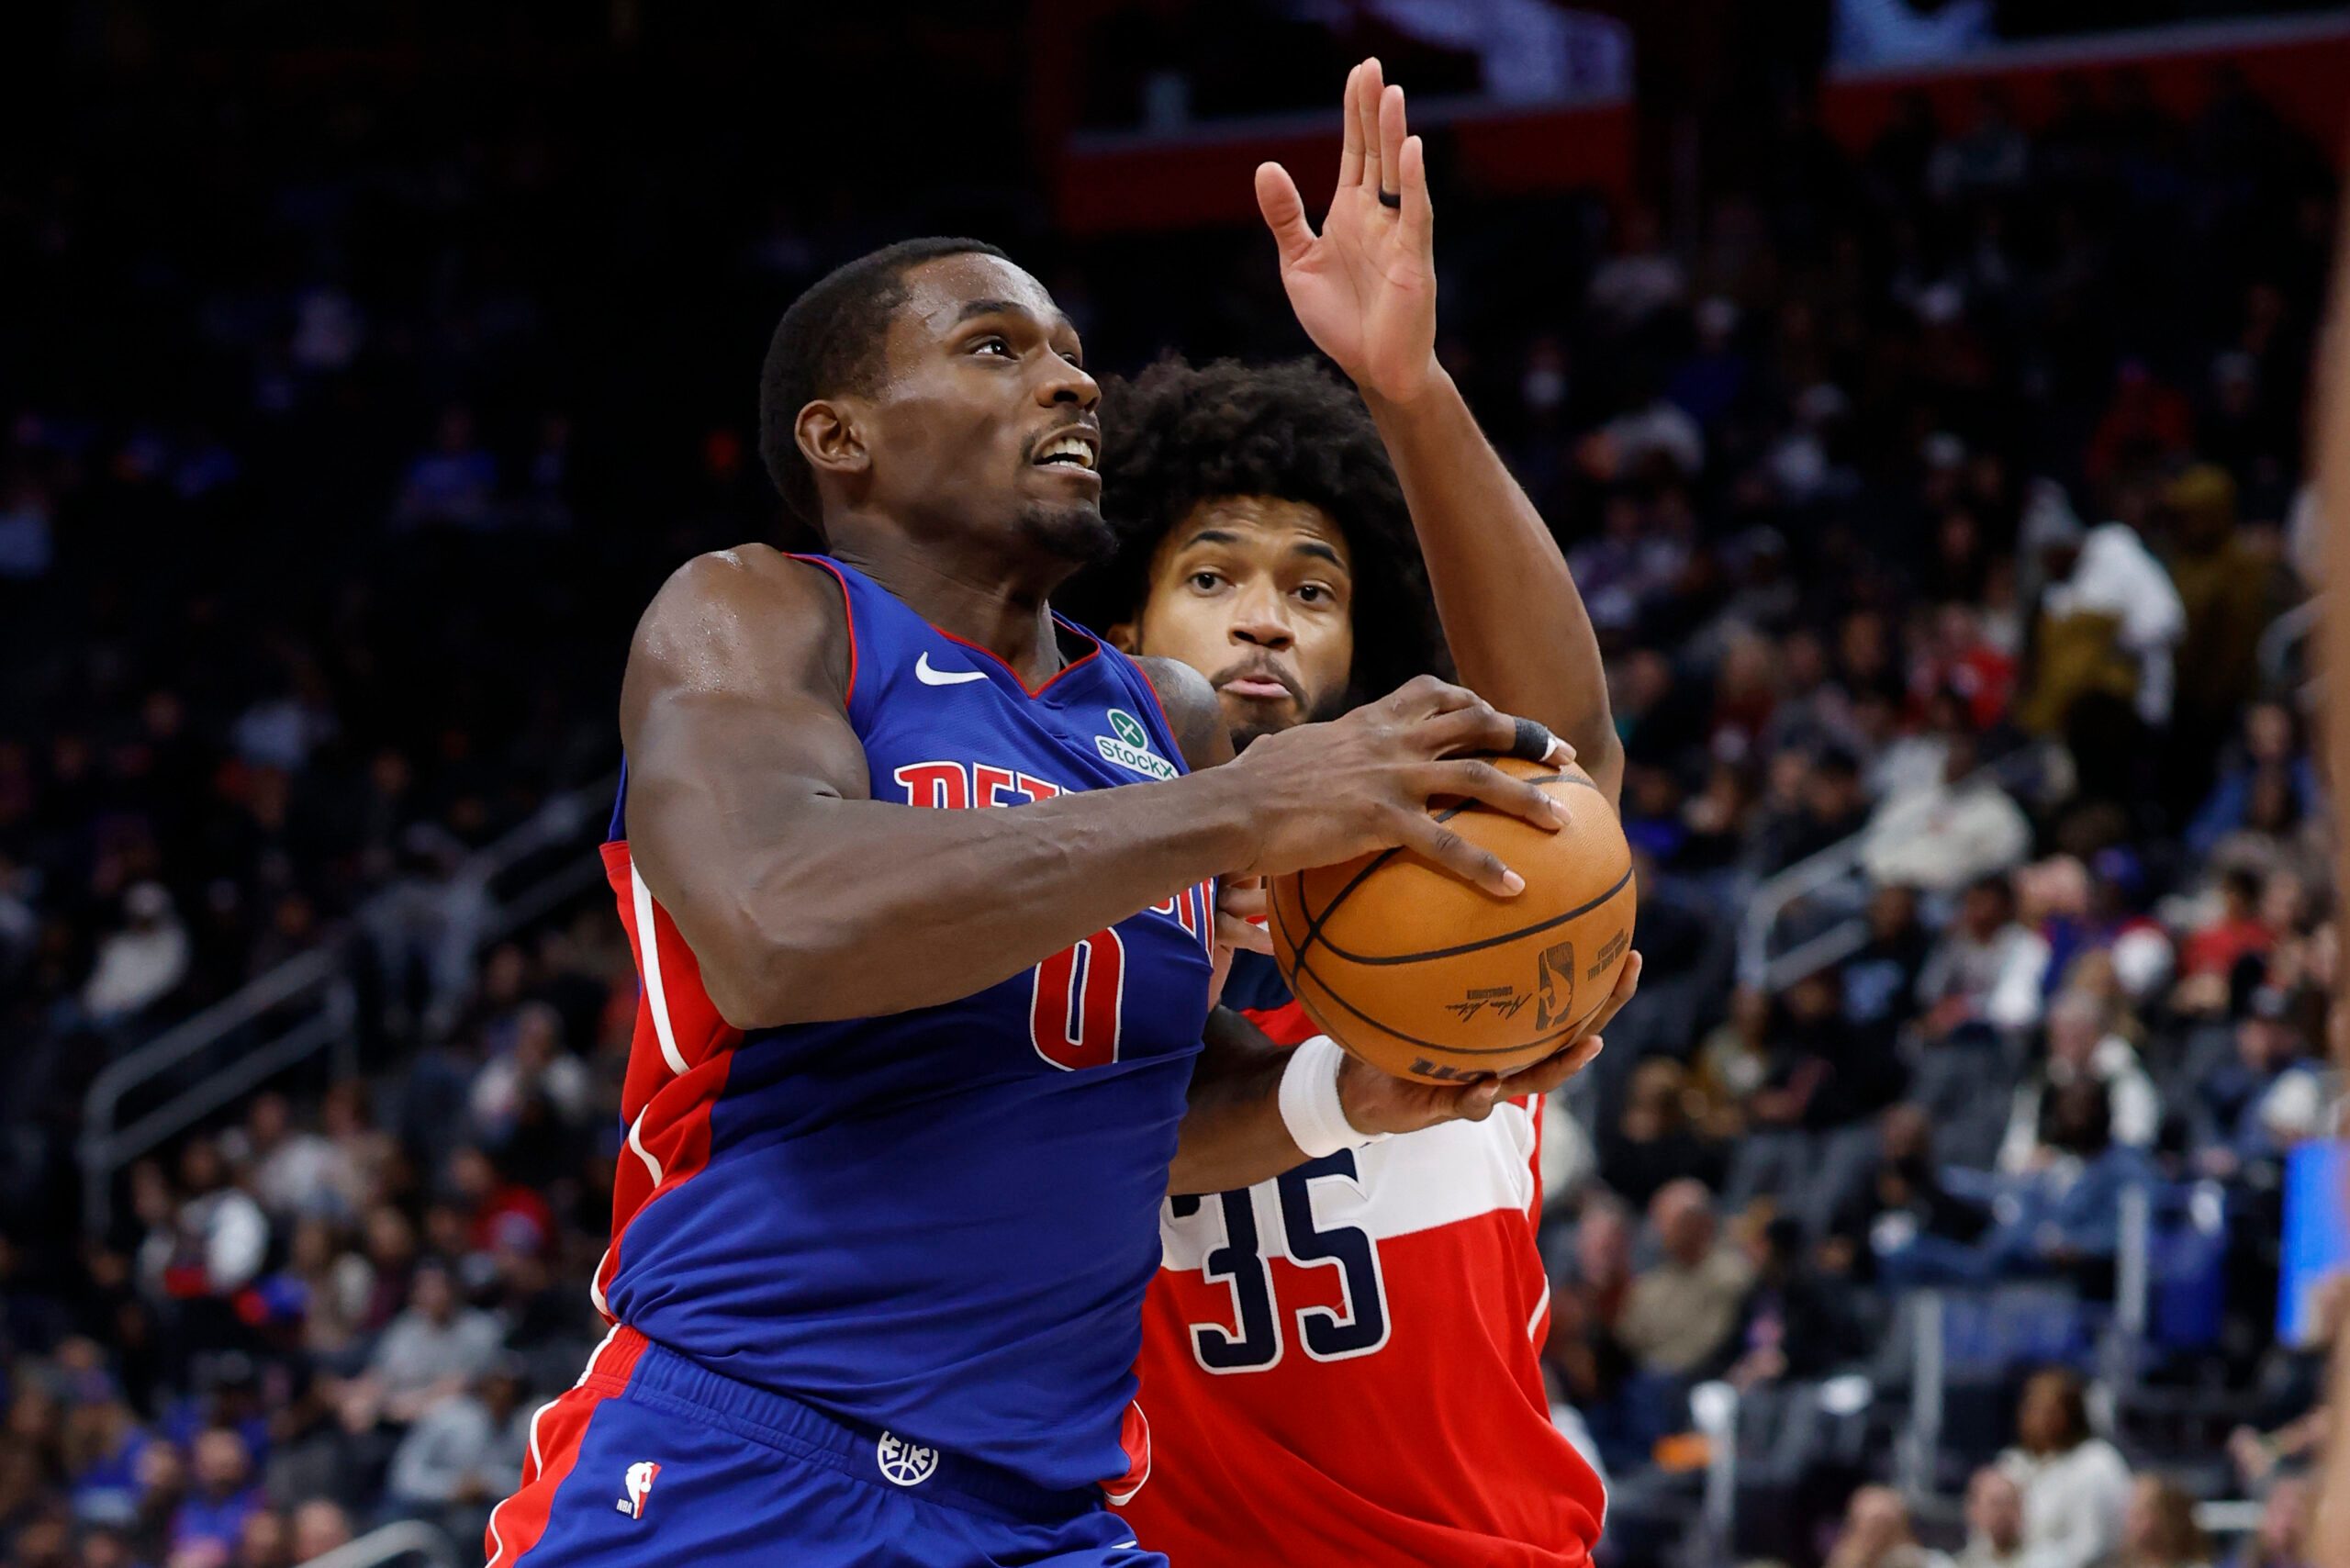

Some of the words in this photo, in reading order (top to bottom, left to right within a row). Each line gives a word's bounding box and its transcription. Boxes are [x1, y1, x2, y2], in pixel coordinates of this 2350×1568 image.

[893, 760, 1215, 969] DEIT
[1030, 926, 1125, 1071] 0
[1166, 1145, 1391, 1375] 35
[616, 1498, 633, 1515] NBA
